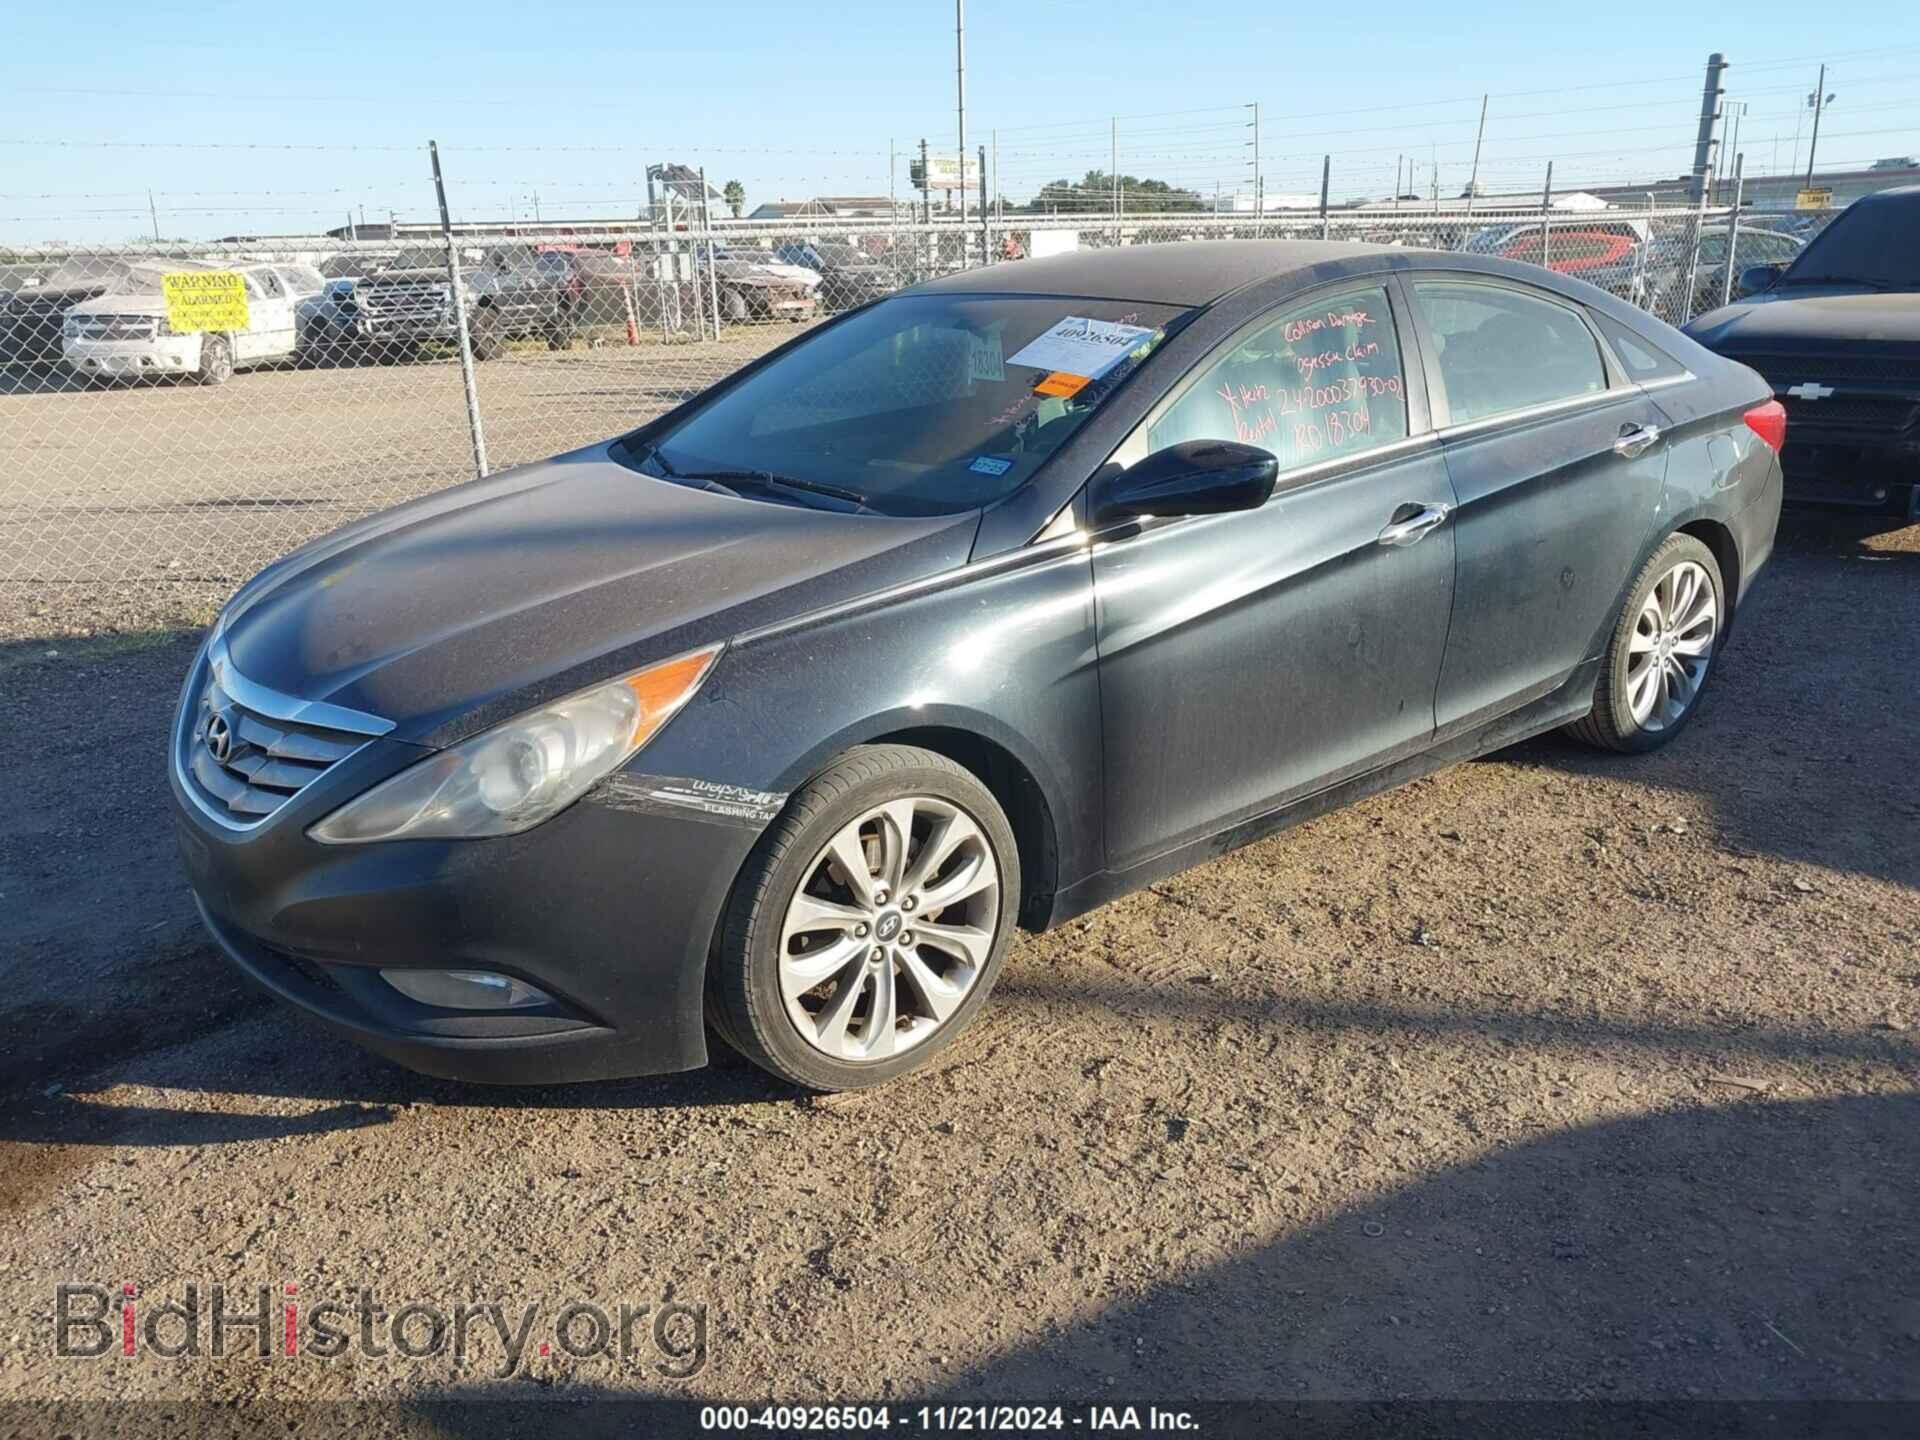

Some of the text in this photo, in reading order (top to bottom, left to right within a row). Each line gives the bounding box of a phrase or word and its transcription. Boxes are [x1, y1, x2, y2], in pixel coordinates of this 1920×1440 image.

[167, 274, 238, 289] WARNING
[1055, 327, 1136, 347] 40926504
[704, 803, 777, 821] FLASHING TAP
